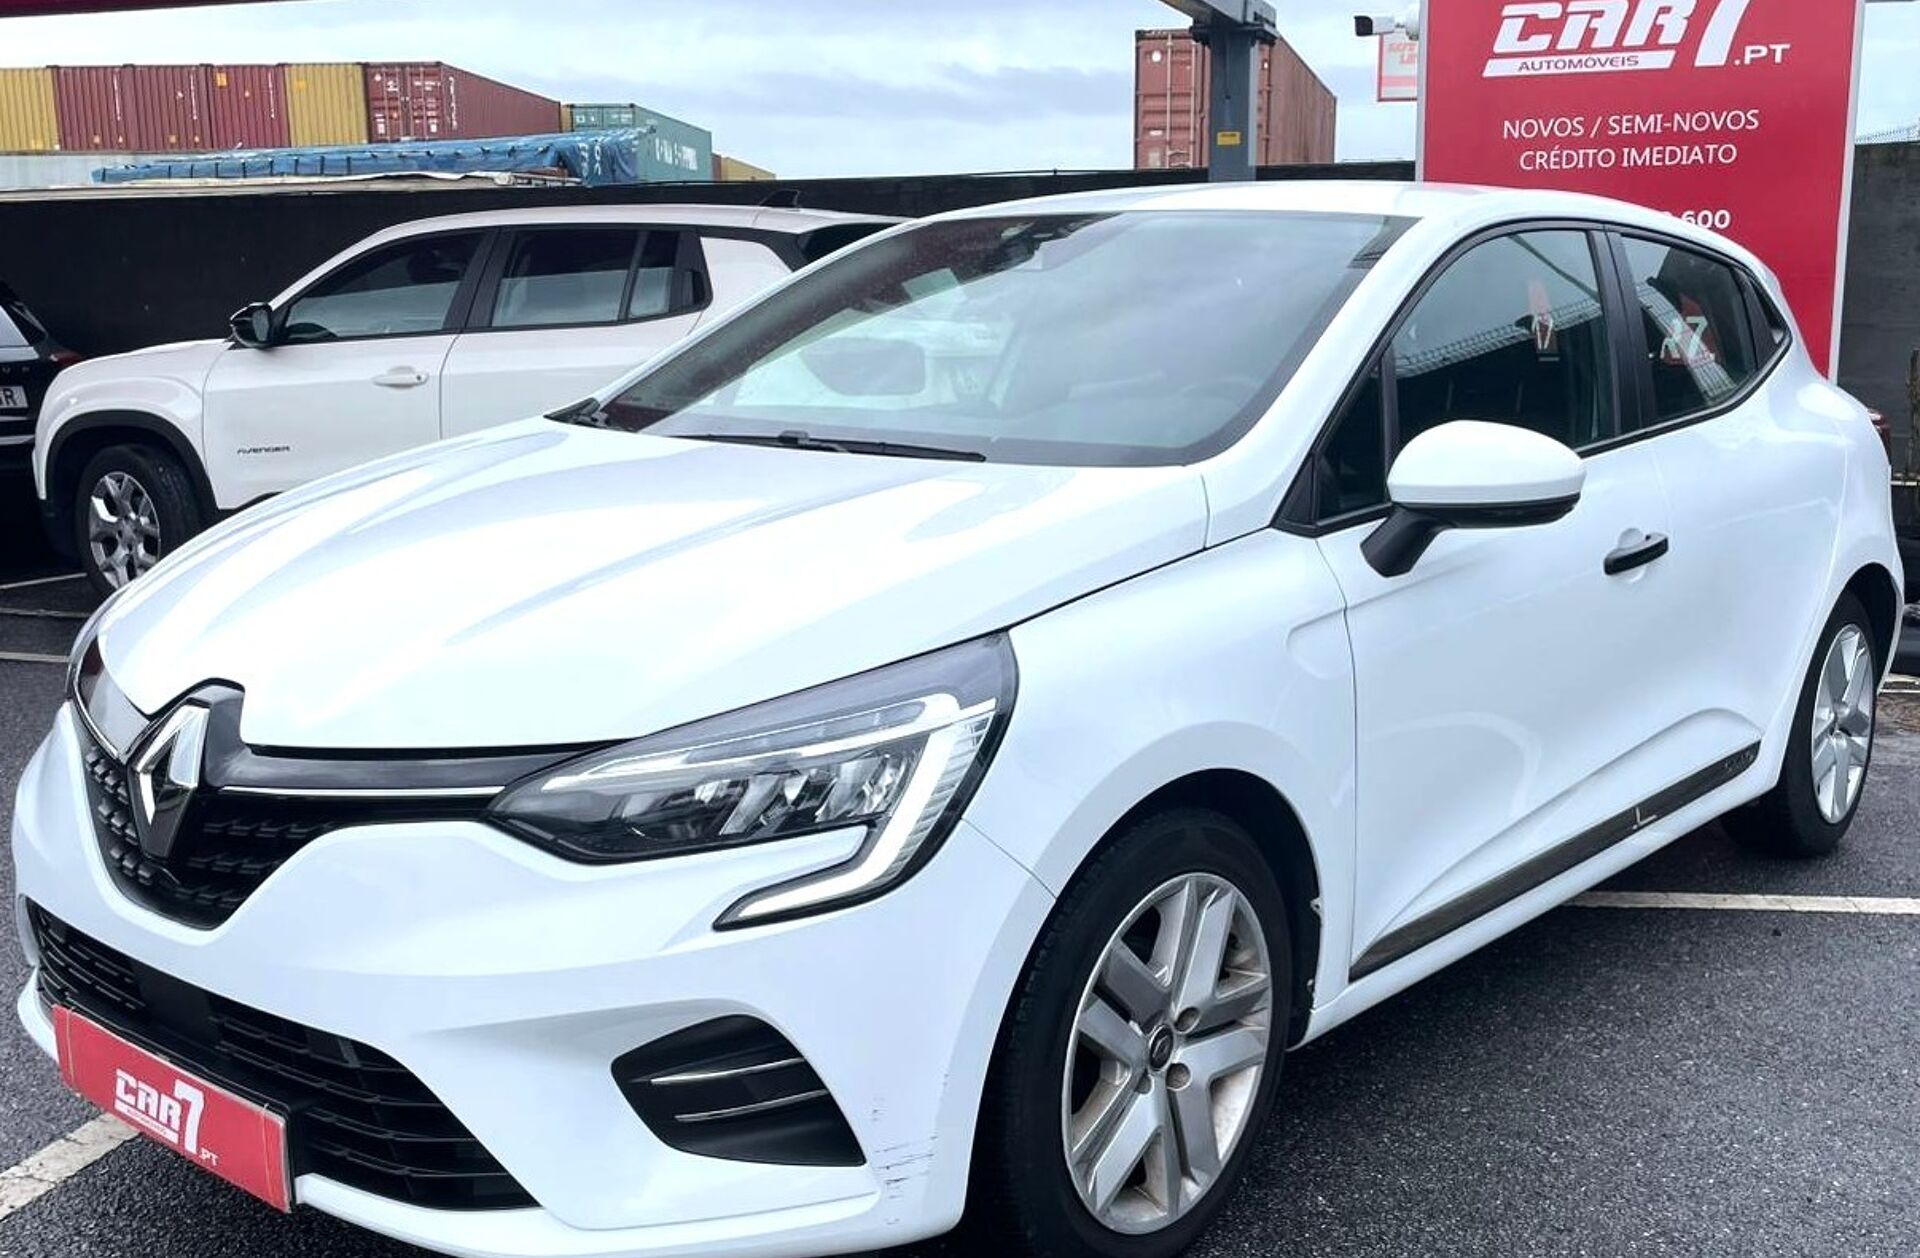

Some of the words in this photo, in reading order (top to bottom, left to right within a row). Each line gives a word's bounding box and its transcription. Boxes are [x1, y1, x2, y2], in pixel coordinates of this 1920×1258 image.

[1517, 55, 1640, 73] AUTOMÓVEIS
[1502, 117, 1585, 139] NOVOS
[1589, 116, 1602, 138] /
[1607, 109, 1760, 135] SEMI-NOVOS
[1518, 145, 1617, 171] CRÉDITO
[1621, 144, 1738, 168] IMEDIATO
